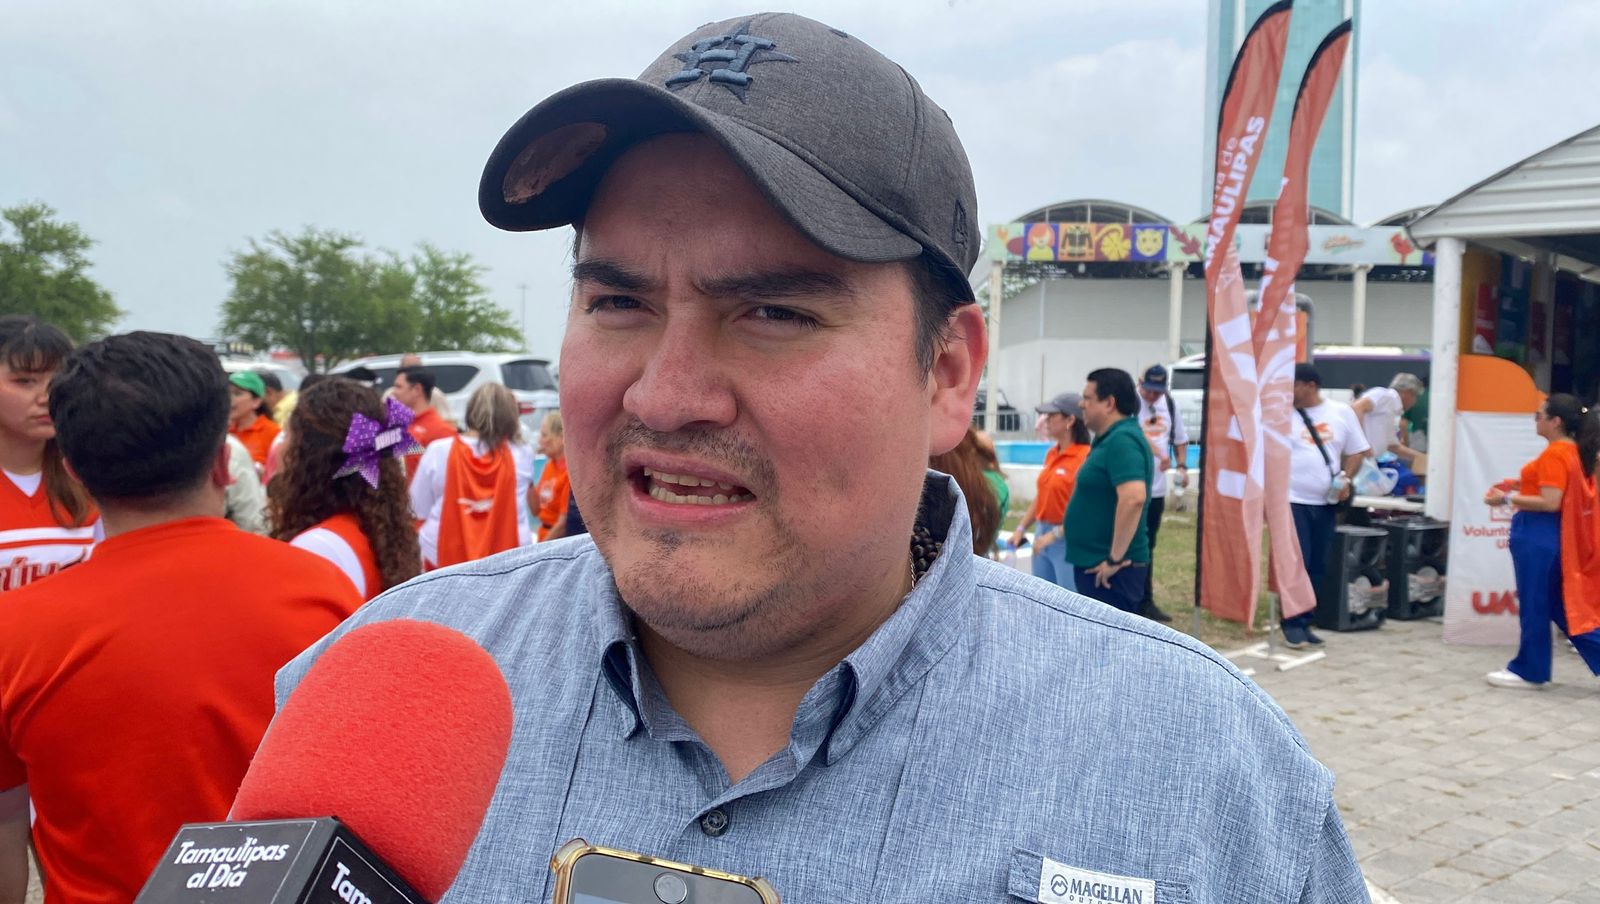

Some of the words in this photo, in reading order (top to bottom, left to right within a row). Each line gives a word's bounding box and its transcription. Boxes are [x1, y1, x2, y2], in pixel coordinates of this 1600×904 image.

[1472, 590, 1519, 615] UA
[174, 837, 290, 869] Tamaulipas
[186, 864, 212, 888] al
[209, 863, 248, 888] Día
[1070, 878, 1142, 904] MAGELLAN
